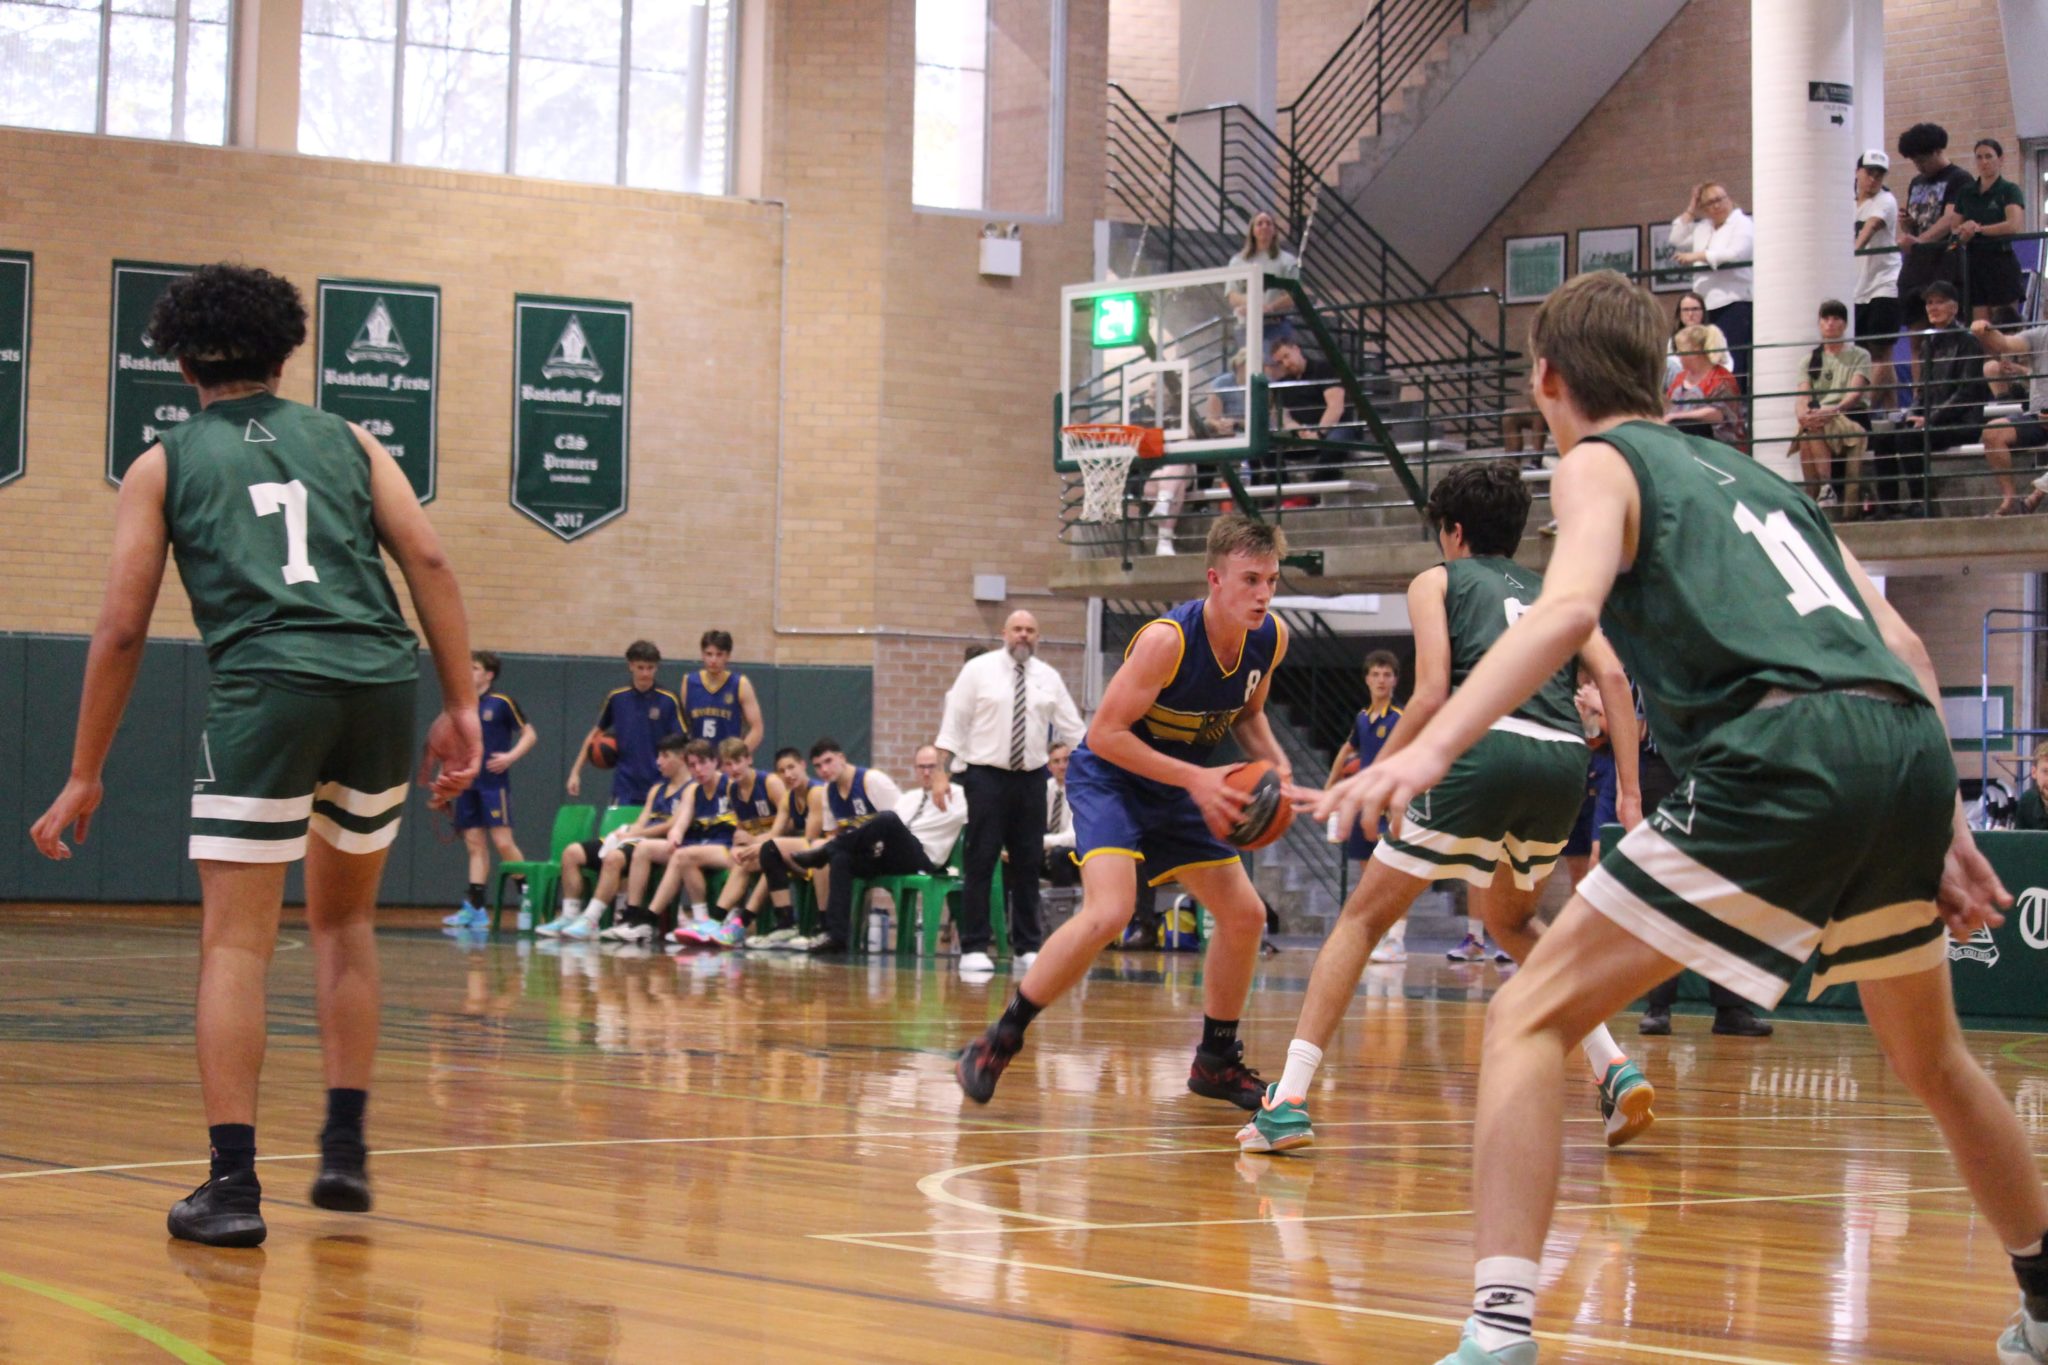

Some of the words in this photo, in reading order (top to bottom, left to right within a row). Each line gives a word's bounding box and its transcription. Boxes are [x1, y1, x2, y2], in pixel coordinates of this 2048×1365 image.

[1099, 299, 1135, 340] 24
[0, 349, 20, 362] sts
[118, 352, 182, 372] Basketbal
[323, 368, 388, 388] Basketball
[390, 373, 431, 391] Firsts
[521, 384, 582, 404] Basketball
[584, 390, 622, 406] Firsts
[554, 433, 588, 450] CAS
[543, 453, 599, 471] Premiers
[554, 511, 584, 528] 2017
[247, 479, 321, 585] 7
[702, 719, 717, 738] 15
